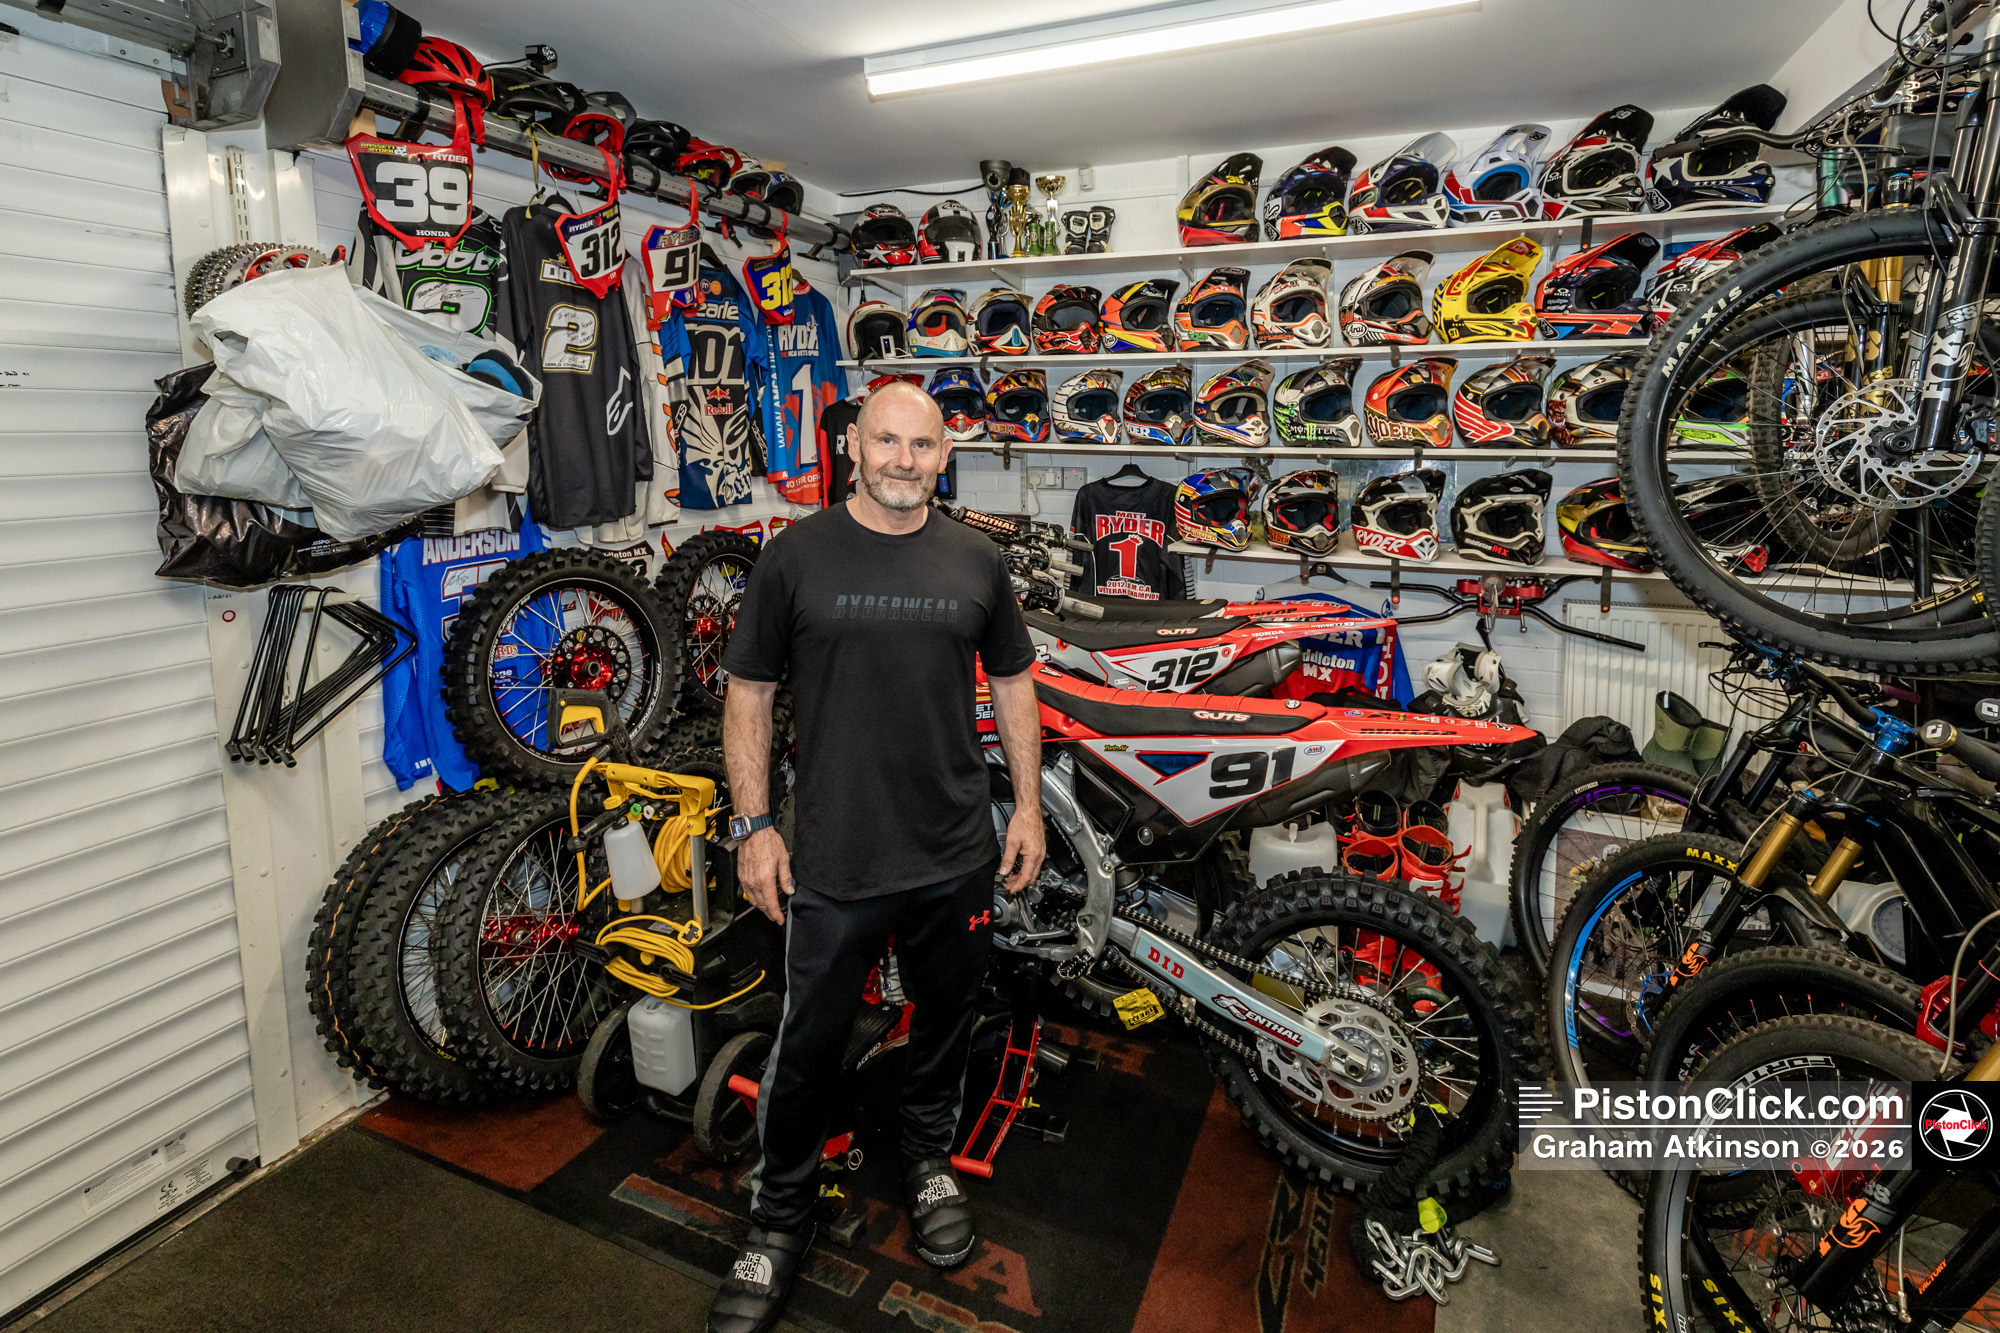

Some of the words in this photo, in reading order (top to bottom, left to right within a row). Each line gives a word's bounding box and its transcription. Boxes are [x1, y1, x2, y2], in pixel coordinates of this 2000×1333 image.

[433, 153, 468, 164] RYDER
[376, 161, 468, 225] 39
[416, 229, 451, 237] HONDA
[569, 220, 593, 232] RYDER
[656, 228, 698, 248] RYDER
[580, 221, 622, 278] 312
[662, 243, 698, 288] 91
[697, 301, 739, 320] earle
[542, 305, 595, 372] 2
[1348, 323, 1365, 335] Arai
[1662, 286, 1742, 378] MAXXIS
[791, 364, 818, 464] 1
[742, 527, 761, 535] RYDER
[965, 511, 1016, 531] RENTHAL
[1096, 514, 1165, 548] RYDER
[423, 529, 520, 566] ANDERSON
[633, 546, 648, 556] MX
[1356, 529, 1406, 553] RYDER
[1465, 537, 1492, 551] Middleton
[1491, 544, 1510, 557] MX
[1109, 538, 1137, 580] 1
[1098, 587, 1127, 595] VETERAN
[1128, 590, 1160, 600] CHAMPION
[1156, 628, 1198, 636] GUTS
[1251, 629, 1285, 638] HONDA
[1303, 649, 1355, 670] ddleton
[1146, 651, 1219, 691] 312
[1303, 663, 1333, 683] MX
[1193, 708, 1250, 724] GUTS
[1359, 728, 1458, 736] DUNLOP
[1209, 746, 1297, 801] 91
[1539, 791, 1574, 825] BUTCHER
[1686, 847, 1737, 872] MAXX
[1147, 947, 1185, 979] D.I.D
[917, 1184, 945, 1202] NORTH
[926, 1177, 943, 1189] THE
[927, 1190, 947, 1205] FACE
[733, 1259, 757, 1271] NORTH
[746, 1252, 761, 1263] THE
[735, 1269, 755, 1281] FACE
[1918, 1258, 1947, 1296] FACTORY
[1649, 1273, 1668, 1333] XIS
